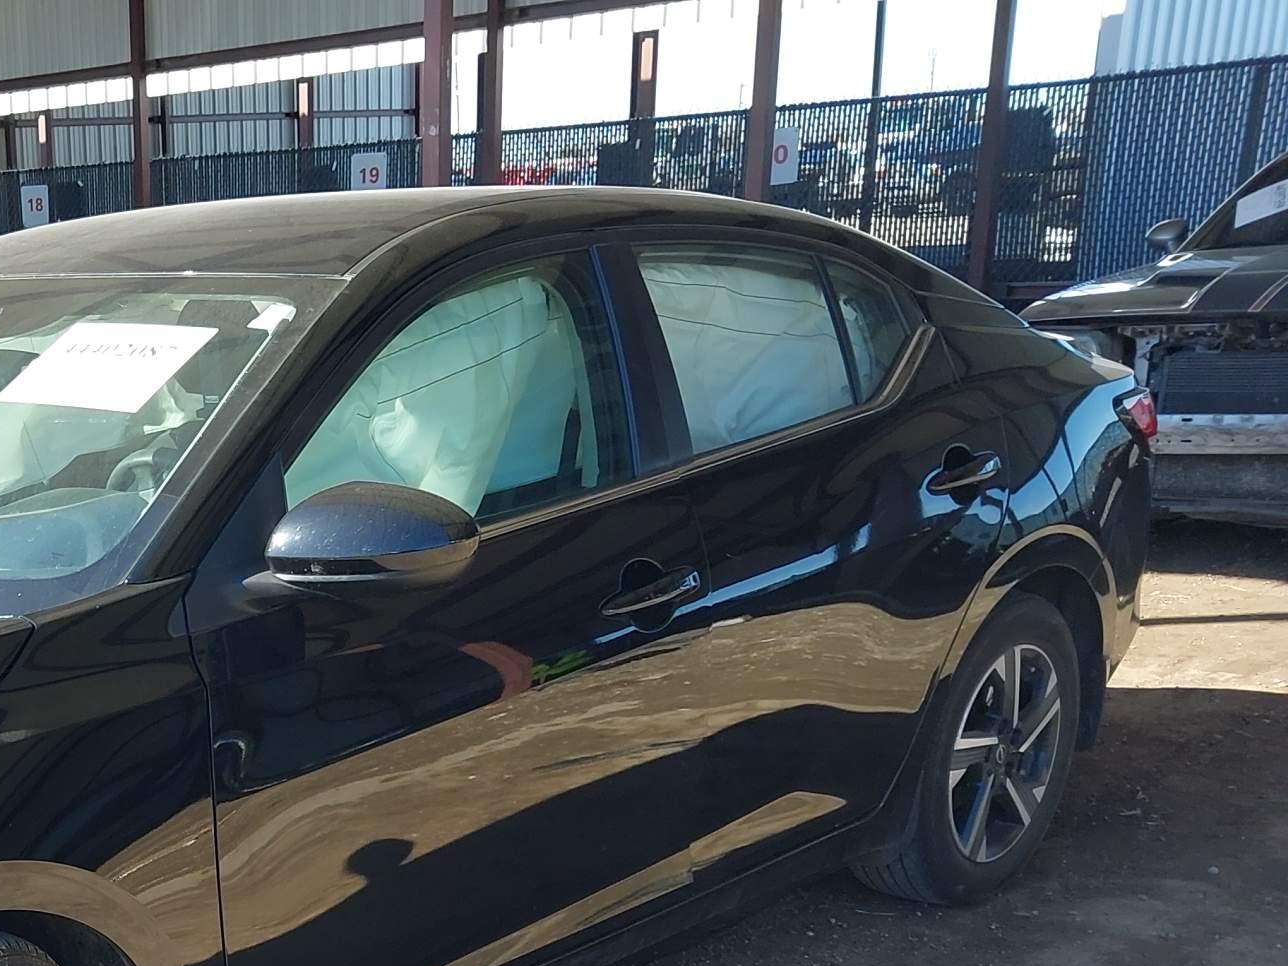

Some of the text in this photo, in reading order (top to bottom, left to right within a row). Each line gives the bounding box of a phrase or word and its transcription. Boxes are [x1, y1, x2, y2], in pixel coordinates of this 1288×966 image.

[774, 144, 789, 165] 0
[359, 166, 380, 184] 19
[27, 197, 44, 212] 18
